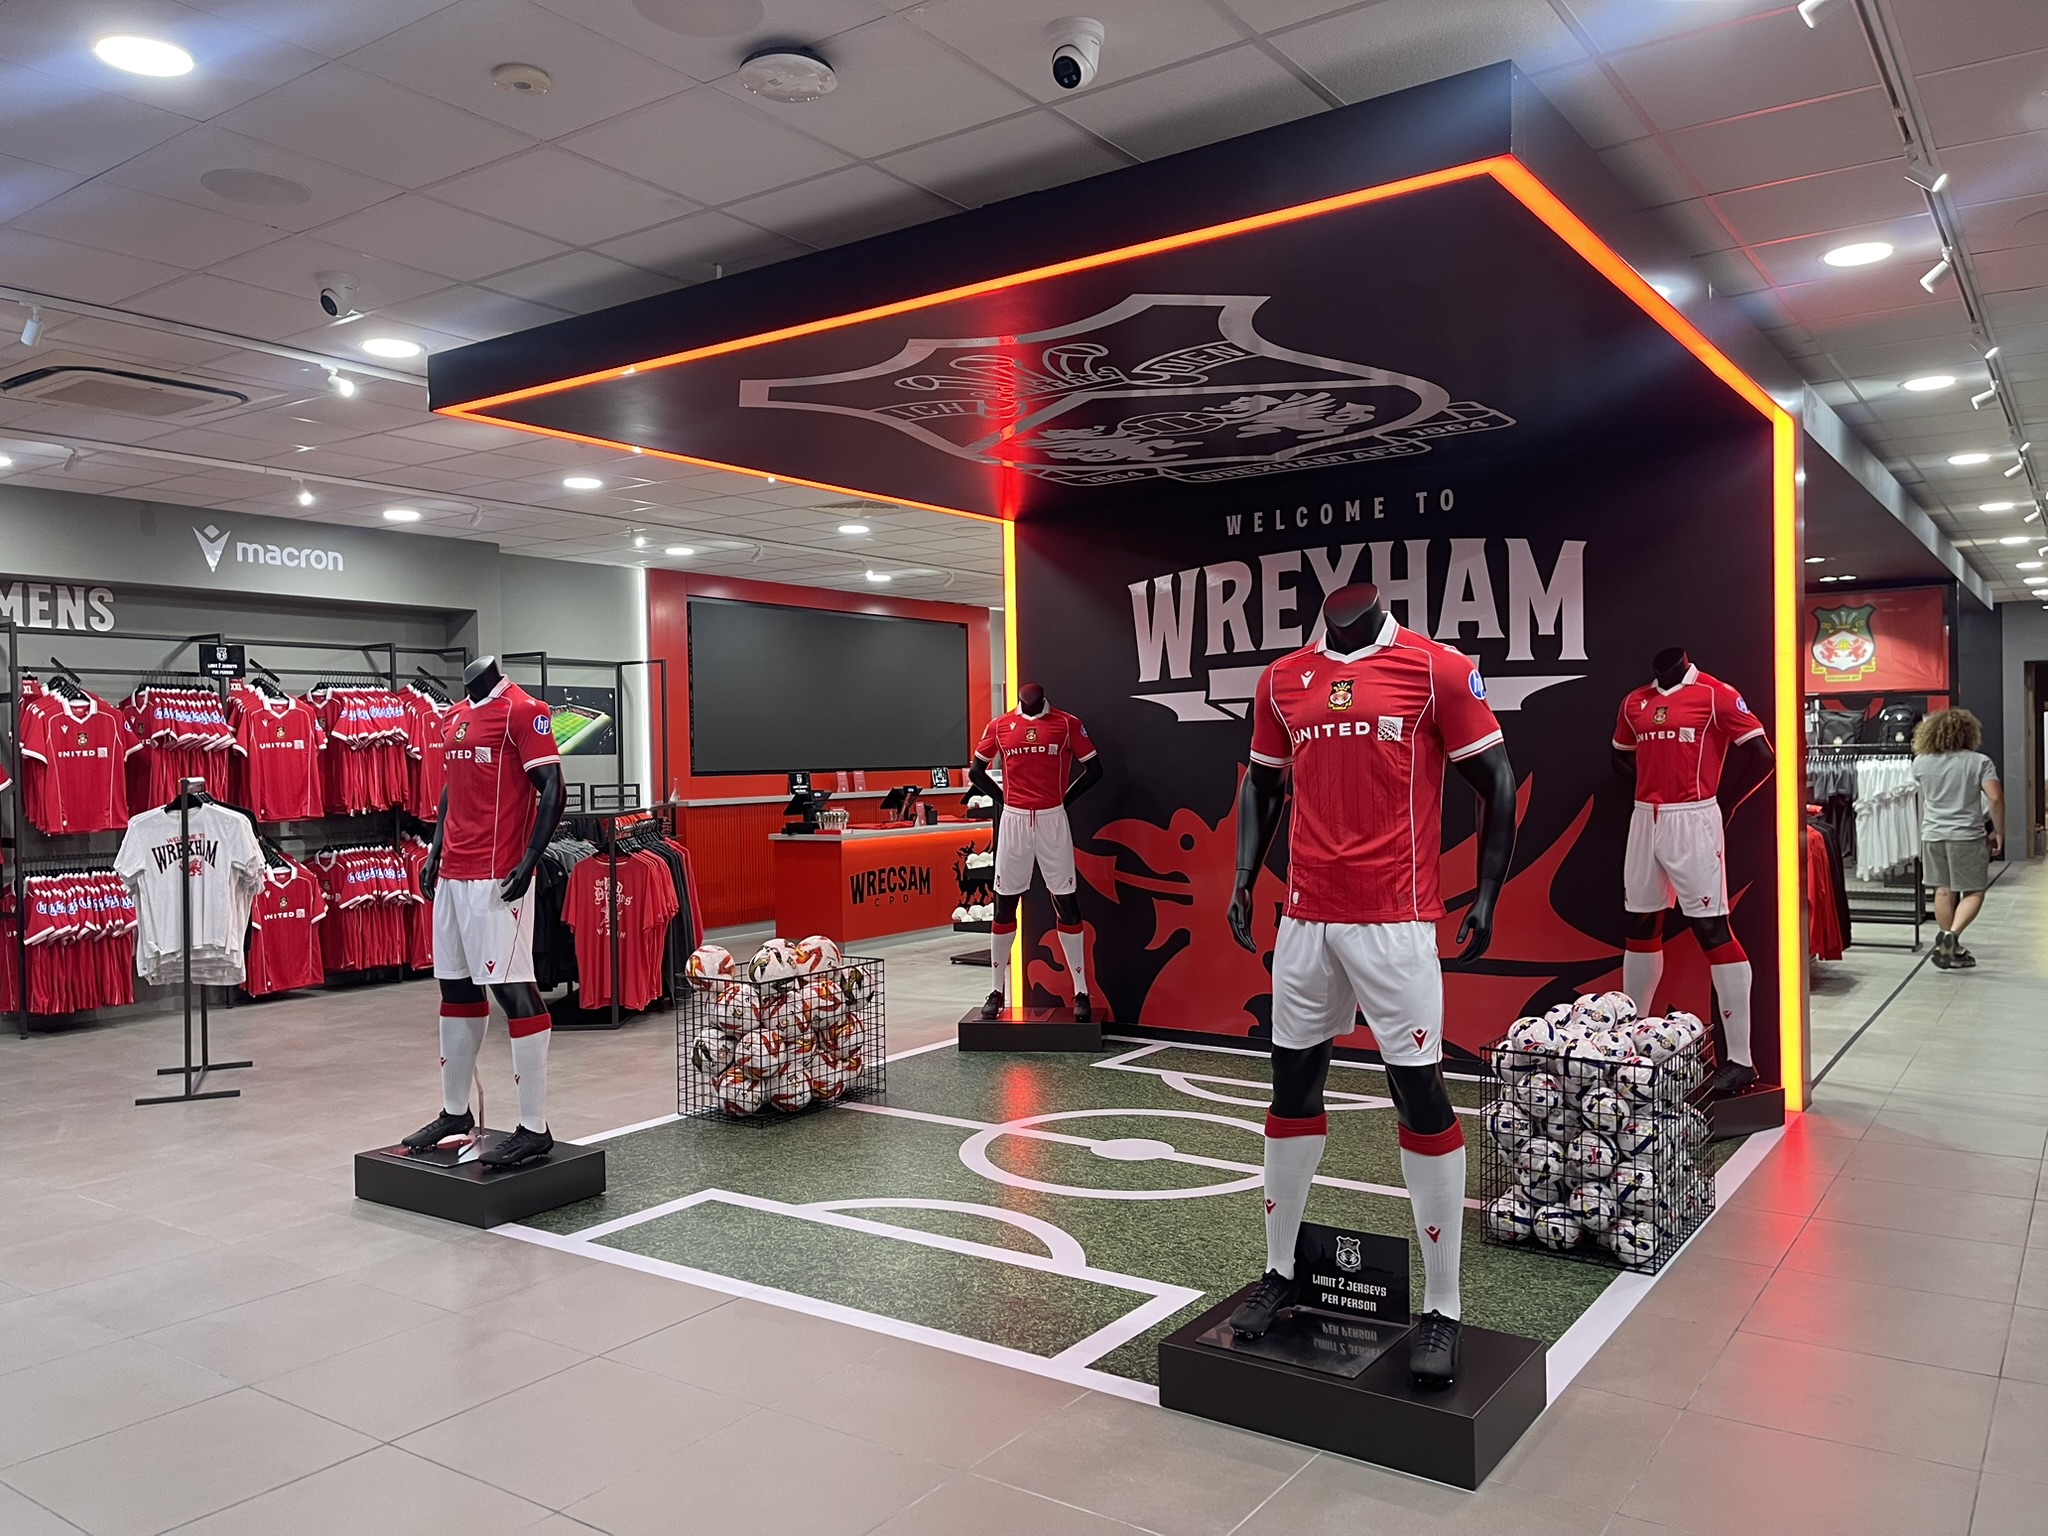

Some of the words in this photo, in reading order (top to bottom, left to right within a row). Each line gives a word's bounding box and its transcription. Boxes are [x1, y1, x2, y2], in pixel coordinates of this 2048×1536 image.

[891, 402, 965, 418] ICH
[1150, 345, 1246, 372] DIEN
[1408, 421, 1490, 436] 1864
[1190, 453, 1348, 480] WREXHAM
[1353, 446, 1414, 459] AFC
[1225, 496, 1385, 536] WELCOME
[1415, 488, 1454, 514] TO
[236, 541, 344, 572] macron
[0, 581, 115, 632] MENS
[1127, 537, 1589, 683] WREXHAM
[23, 685, 33, 694] XL
[230, 683, 243, 691] XXL
[536, 715, 550, 735] hp
[1291, 721, 1371, 745] UNITED
[259, 741, 293, 750] UNITED
[1637, 731, 1676, 742] NITED
[1005, 746, 1046, 756] UNITED
[849, 865, 931, 905] WRECSAM
[874, 894, 909, 907] CPD
[1312, 1273, 1337, 1288] LIMIT
[1338, 1277, 1345, 1290] 2
[1346, 1281, 1387, 1297] JERSEYS
[1321, 1292, 1339, 1305] PER
[1341, 1296, 1377, 1312] PERSON
